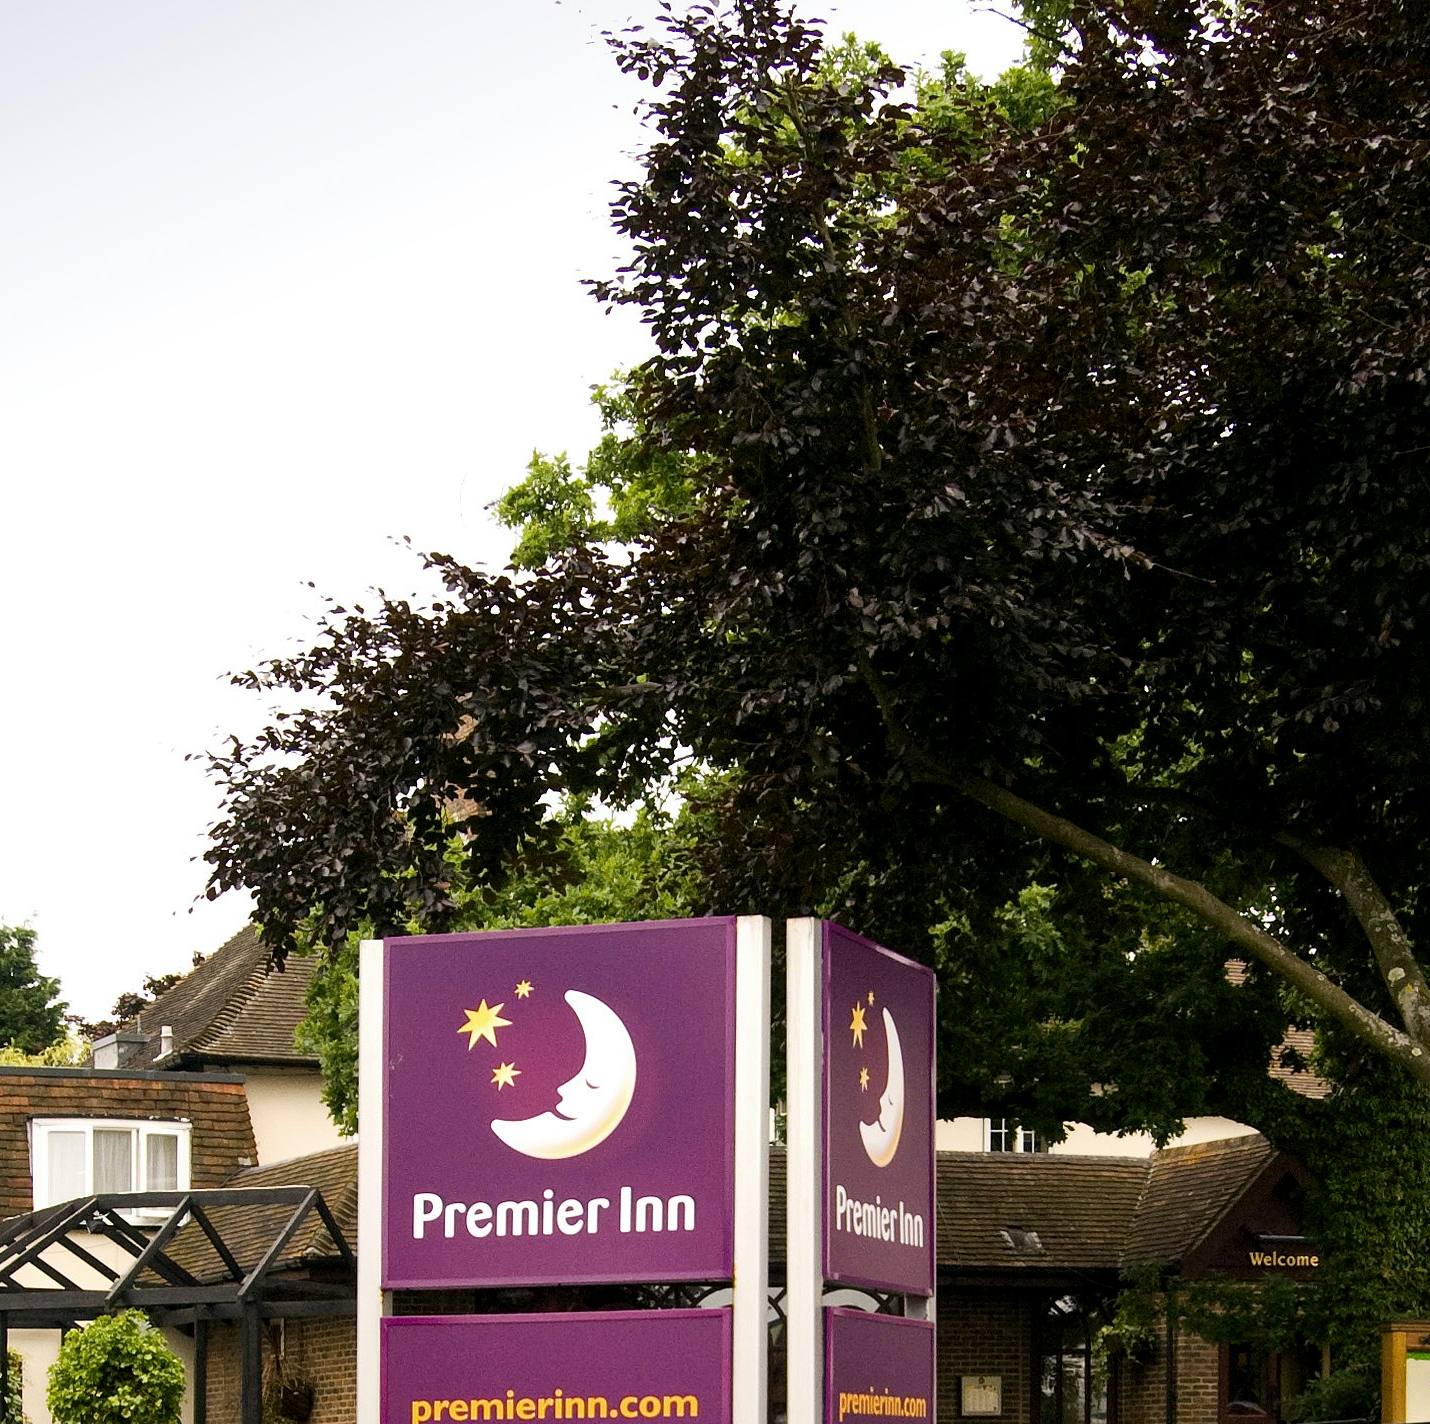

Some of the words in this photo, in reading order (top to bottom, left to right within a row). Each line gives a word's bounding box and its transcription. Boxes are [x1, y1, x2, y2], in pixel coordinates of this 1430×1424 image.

[413, 1188, 610, 1239] Premier
[619, 1186, 695, 1233] Inn
[836, 1184, 898, 1242] Premier
[899, 1200, 924, 1248] Inn
[1249, 1250, 1319, 1267] Welcome
[839, 1386, 927, 1422] premierinn.com
